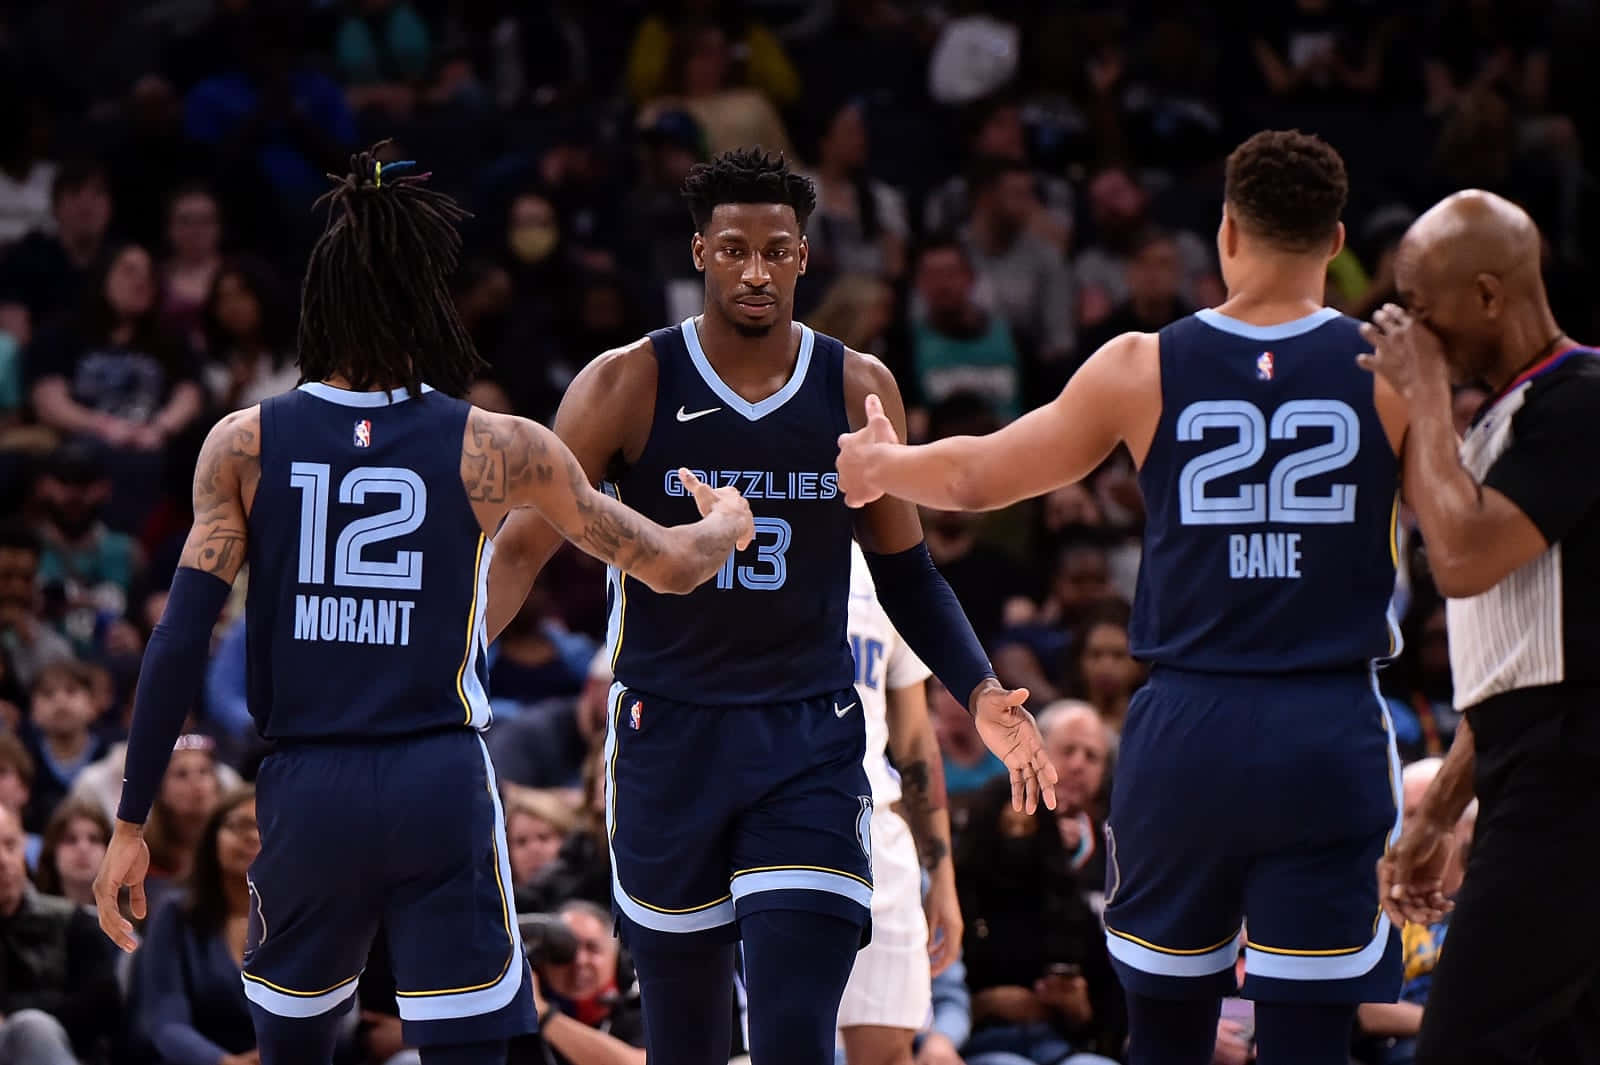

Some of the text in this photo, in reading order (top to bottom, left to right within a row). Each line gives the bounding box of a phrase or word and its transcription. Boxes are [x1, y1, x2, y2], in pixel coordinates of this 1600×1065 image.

[1176, 399, 1361, 526] 22
[290, 461, 428, 591] 12
[1228, 532, 1302, 580] BANE
[293, 594, 416, 646] MORANT
